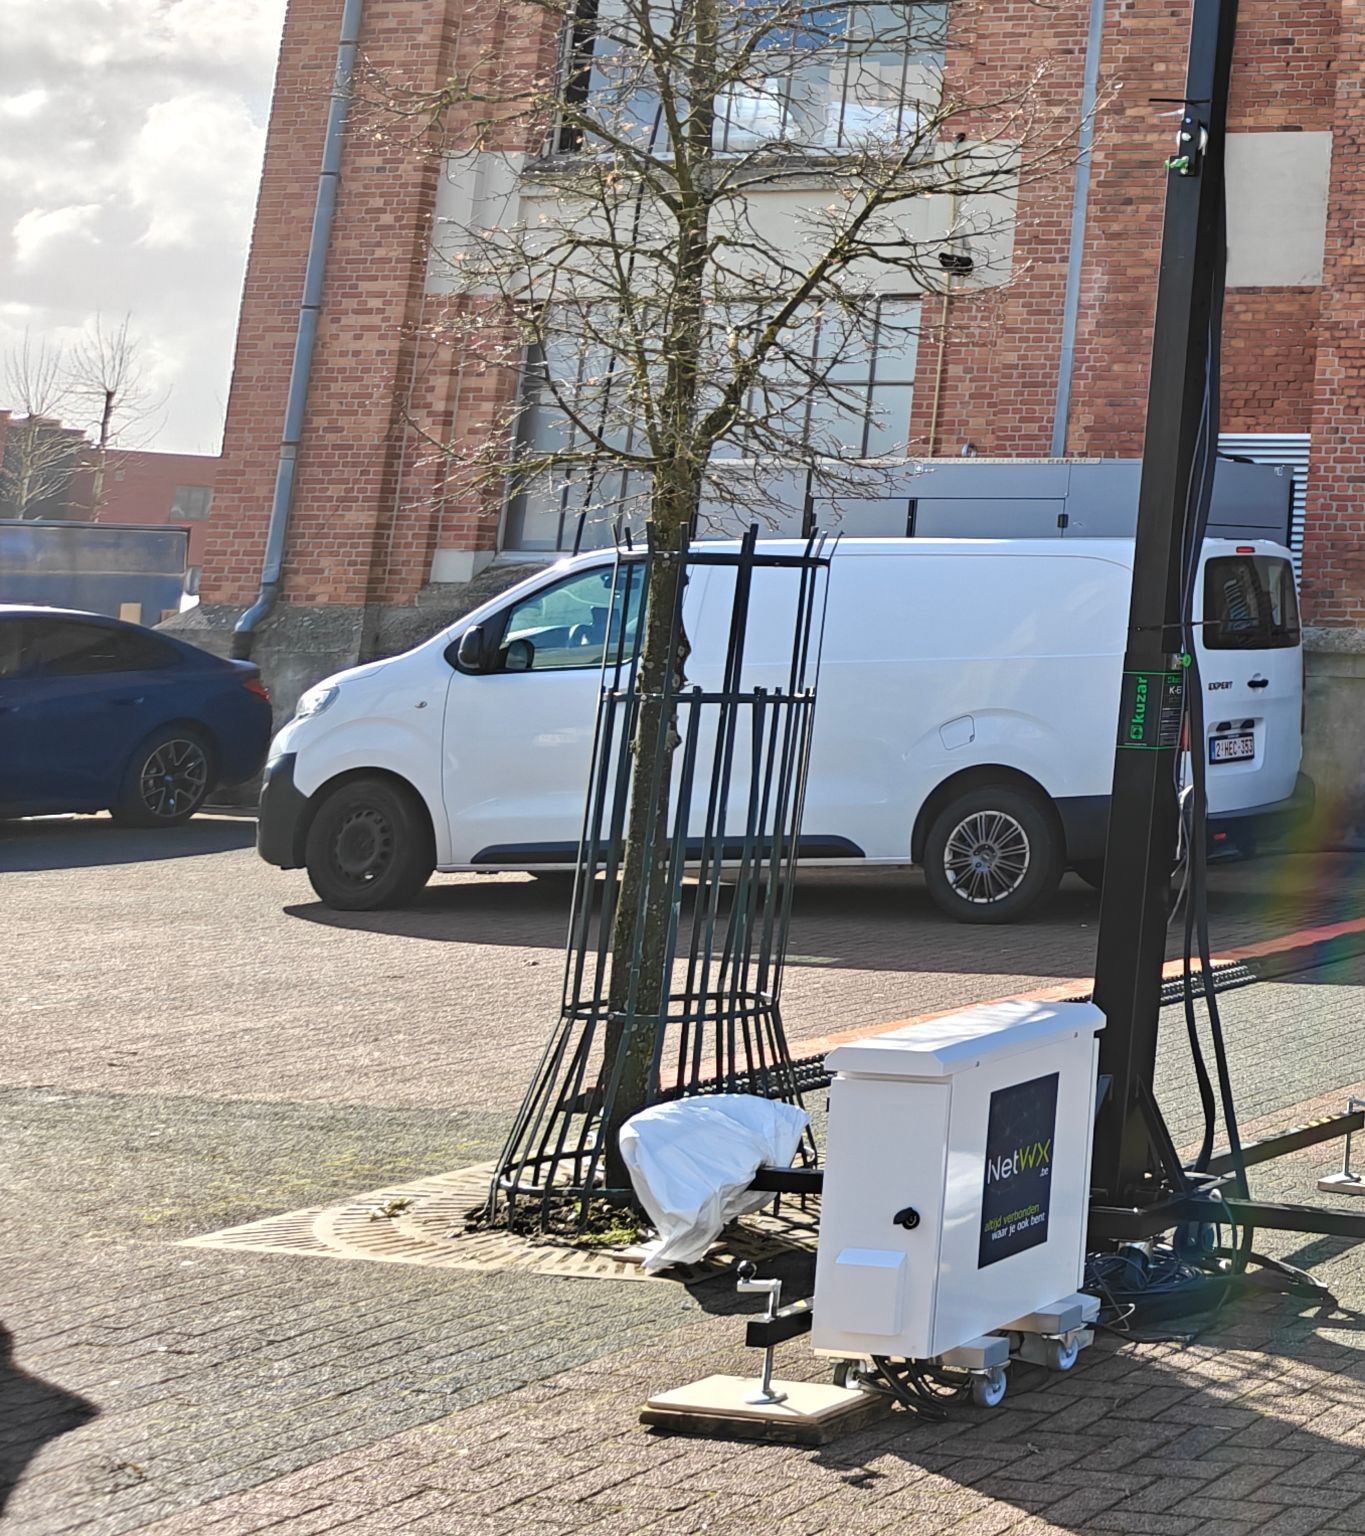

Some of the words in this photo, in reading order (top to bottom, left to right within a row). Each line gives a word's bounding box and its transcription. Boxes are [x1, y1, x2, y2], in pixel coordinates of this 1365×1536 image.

[1132, 676, 1148, 723] kuzar
[1208, 681, 1233, 691] EXPERT
[988, 1138, 1051, 1184] NetWX
[984, 1216, 1002, 1232] altijd
[1003, 1204, 1040, 1224] verbonden
[991, 1227, 1008, 1241] waar
[1008, 1224, 1016, 1237] je
[1016, 1218, 1030, 1231] ook
[1030, 1212, 1045, 1226] bent
